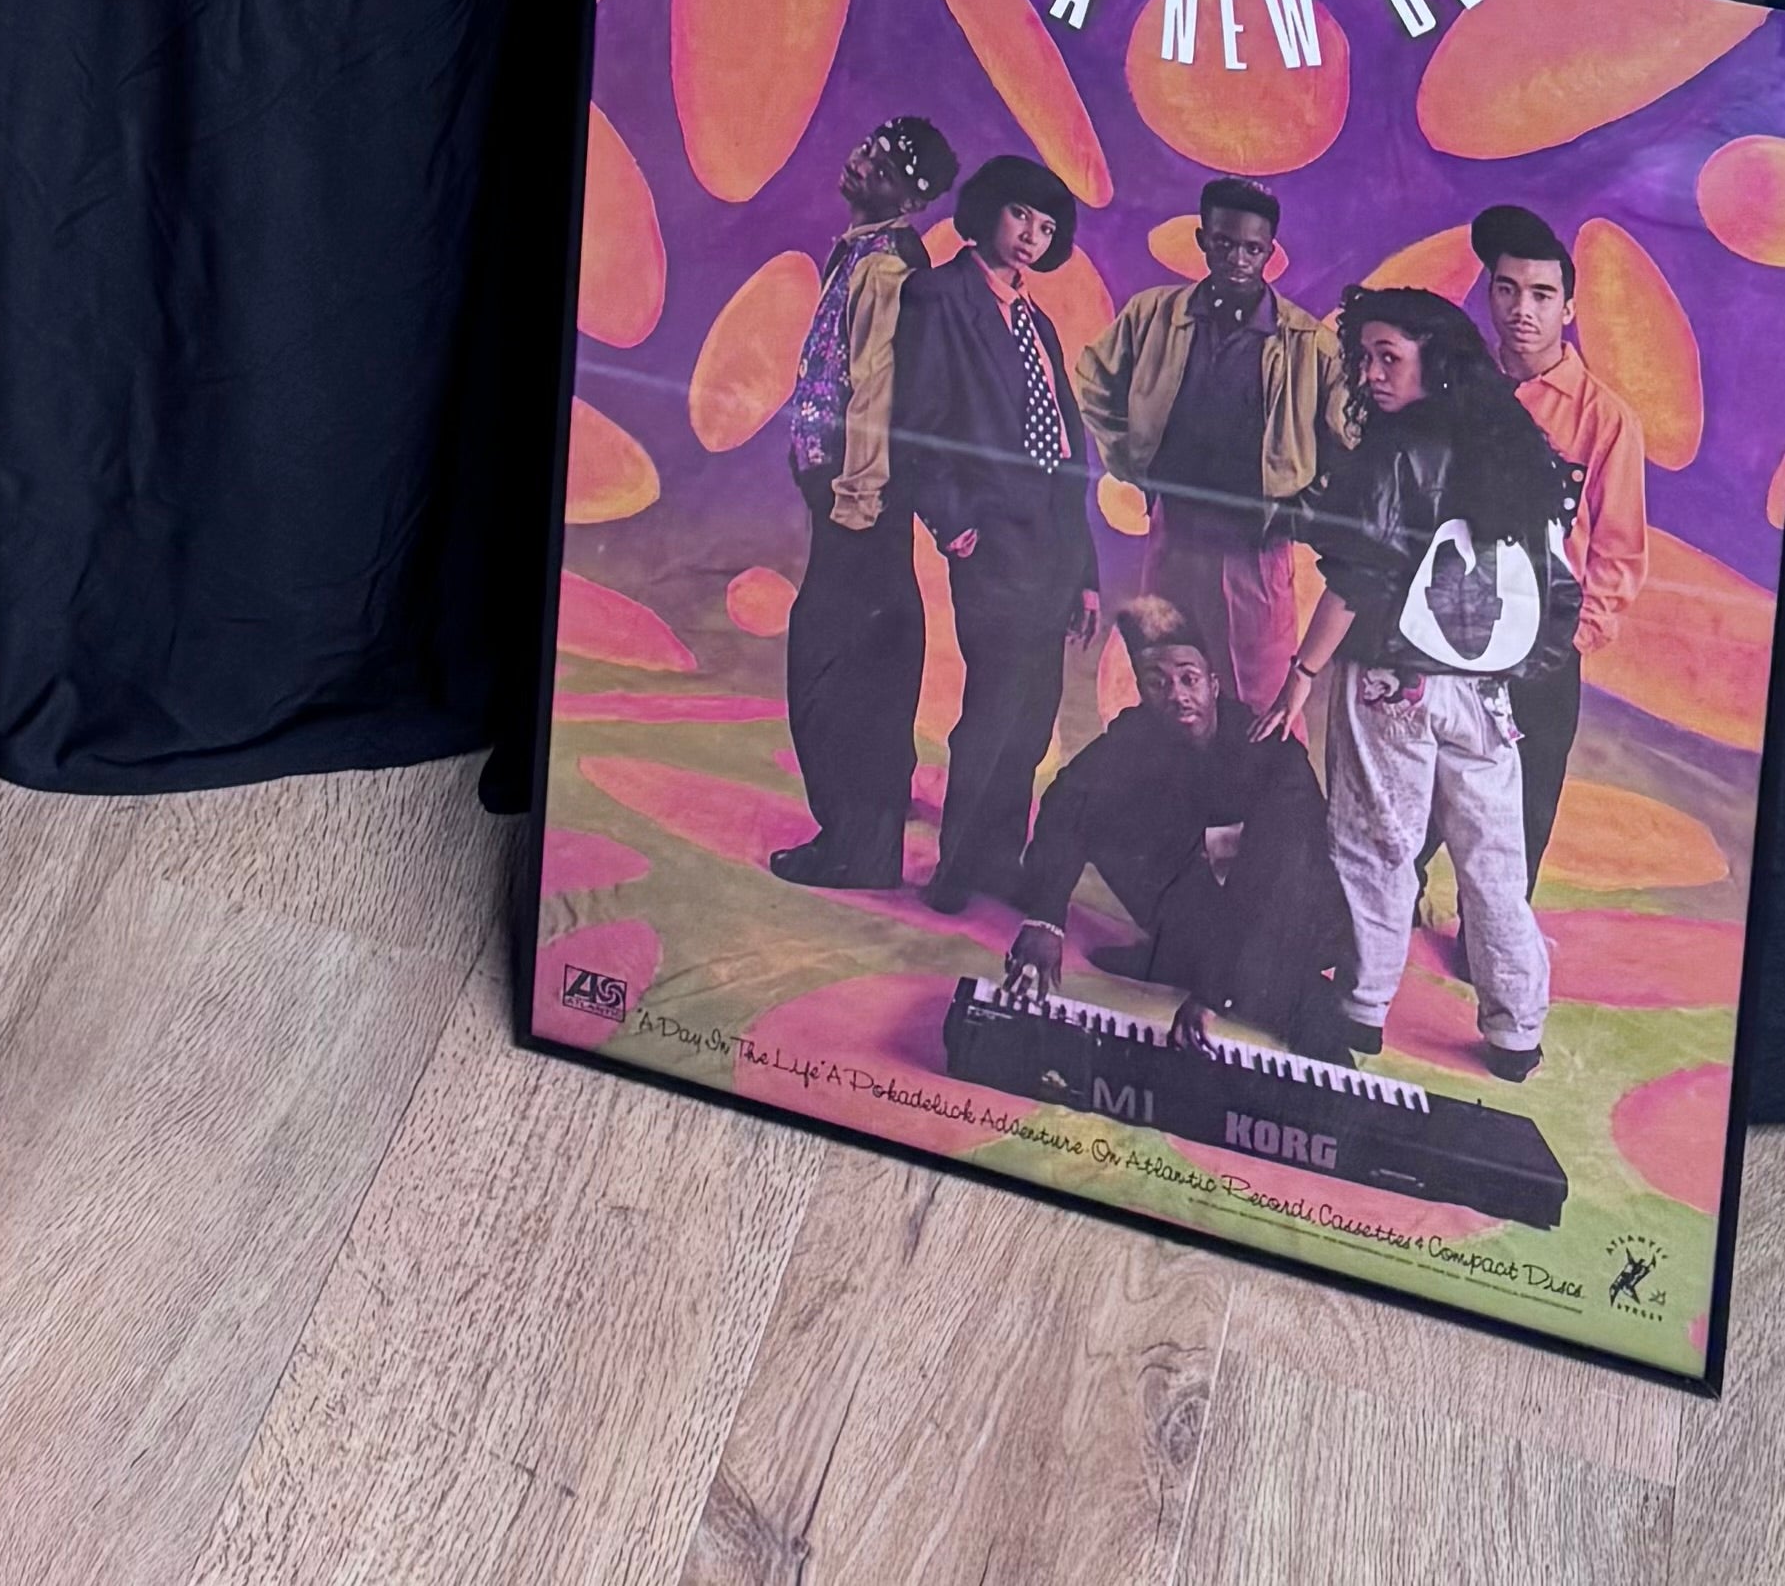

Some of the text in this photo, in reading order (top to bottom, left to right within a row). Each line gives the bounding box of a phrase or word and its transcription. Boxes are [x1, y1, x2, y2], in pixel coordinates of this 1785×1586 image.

[730, 1035, 770, 1067] The
[1125, 1150, 1217, 1194] Atlantic
[1318, 1202, 1412, 1252] Cassettes
[1427, 1234, 1520, 1283] Compact
[1224, 1109, 1338, 1170] KORG
